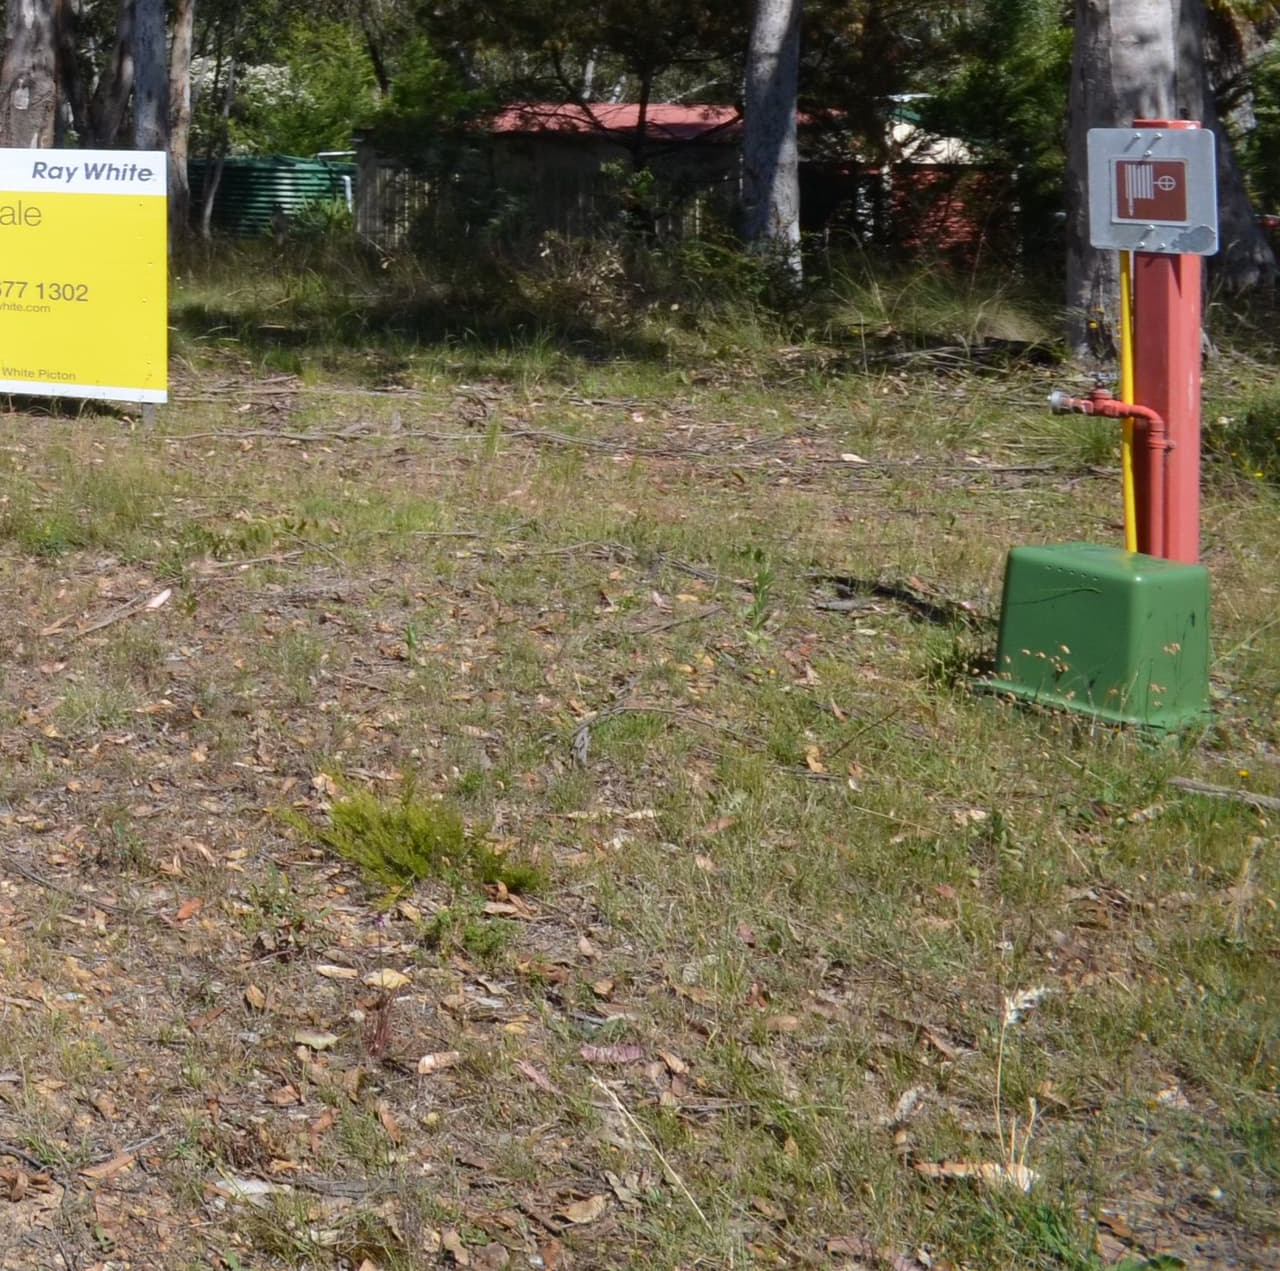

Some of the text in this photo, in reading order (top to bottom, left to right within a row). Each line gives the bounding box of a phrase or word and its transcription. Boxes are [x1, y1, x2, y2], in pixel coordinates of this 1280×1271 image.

[32, 161, 153, 183] Ray White
[35, 283, 89, 302] 1302
[1, 366, 36, 379] White
[38, 369, 77, 382] Picton
